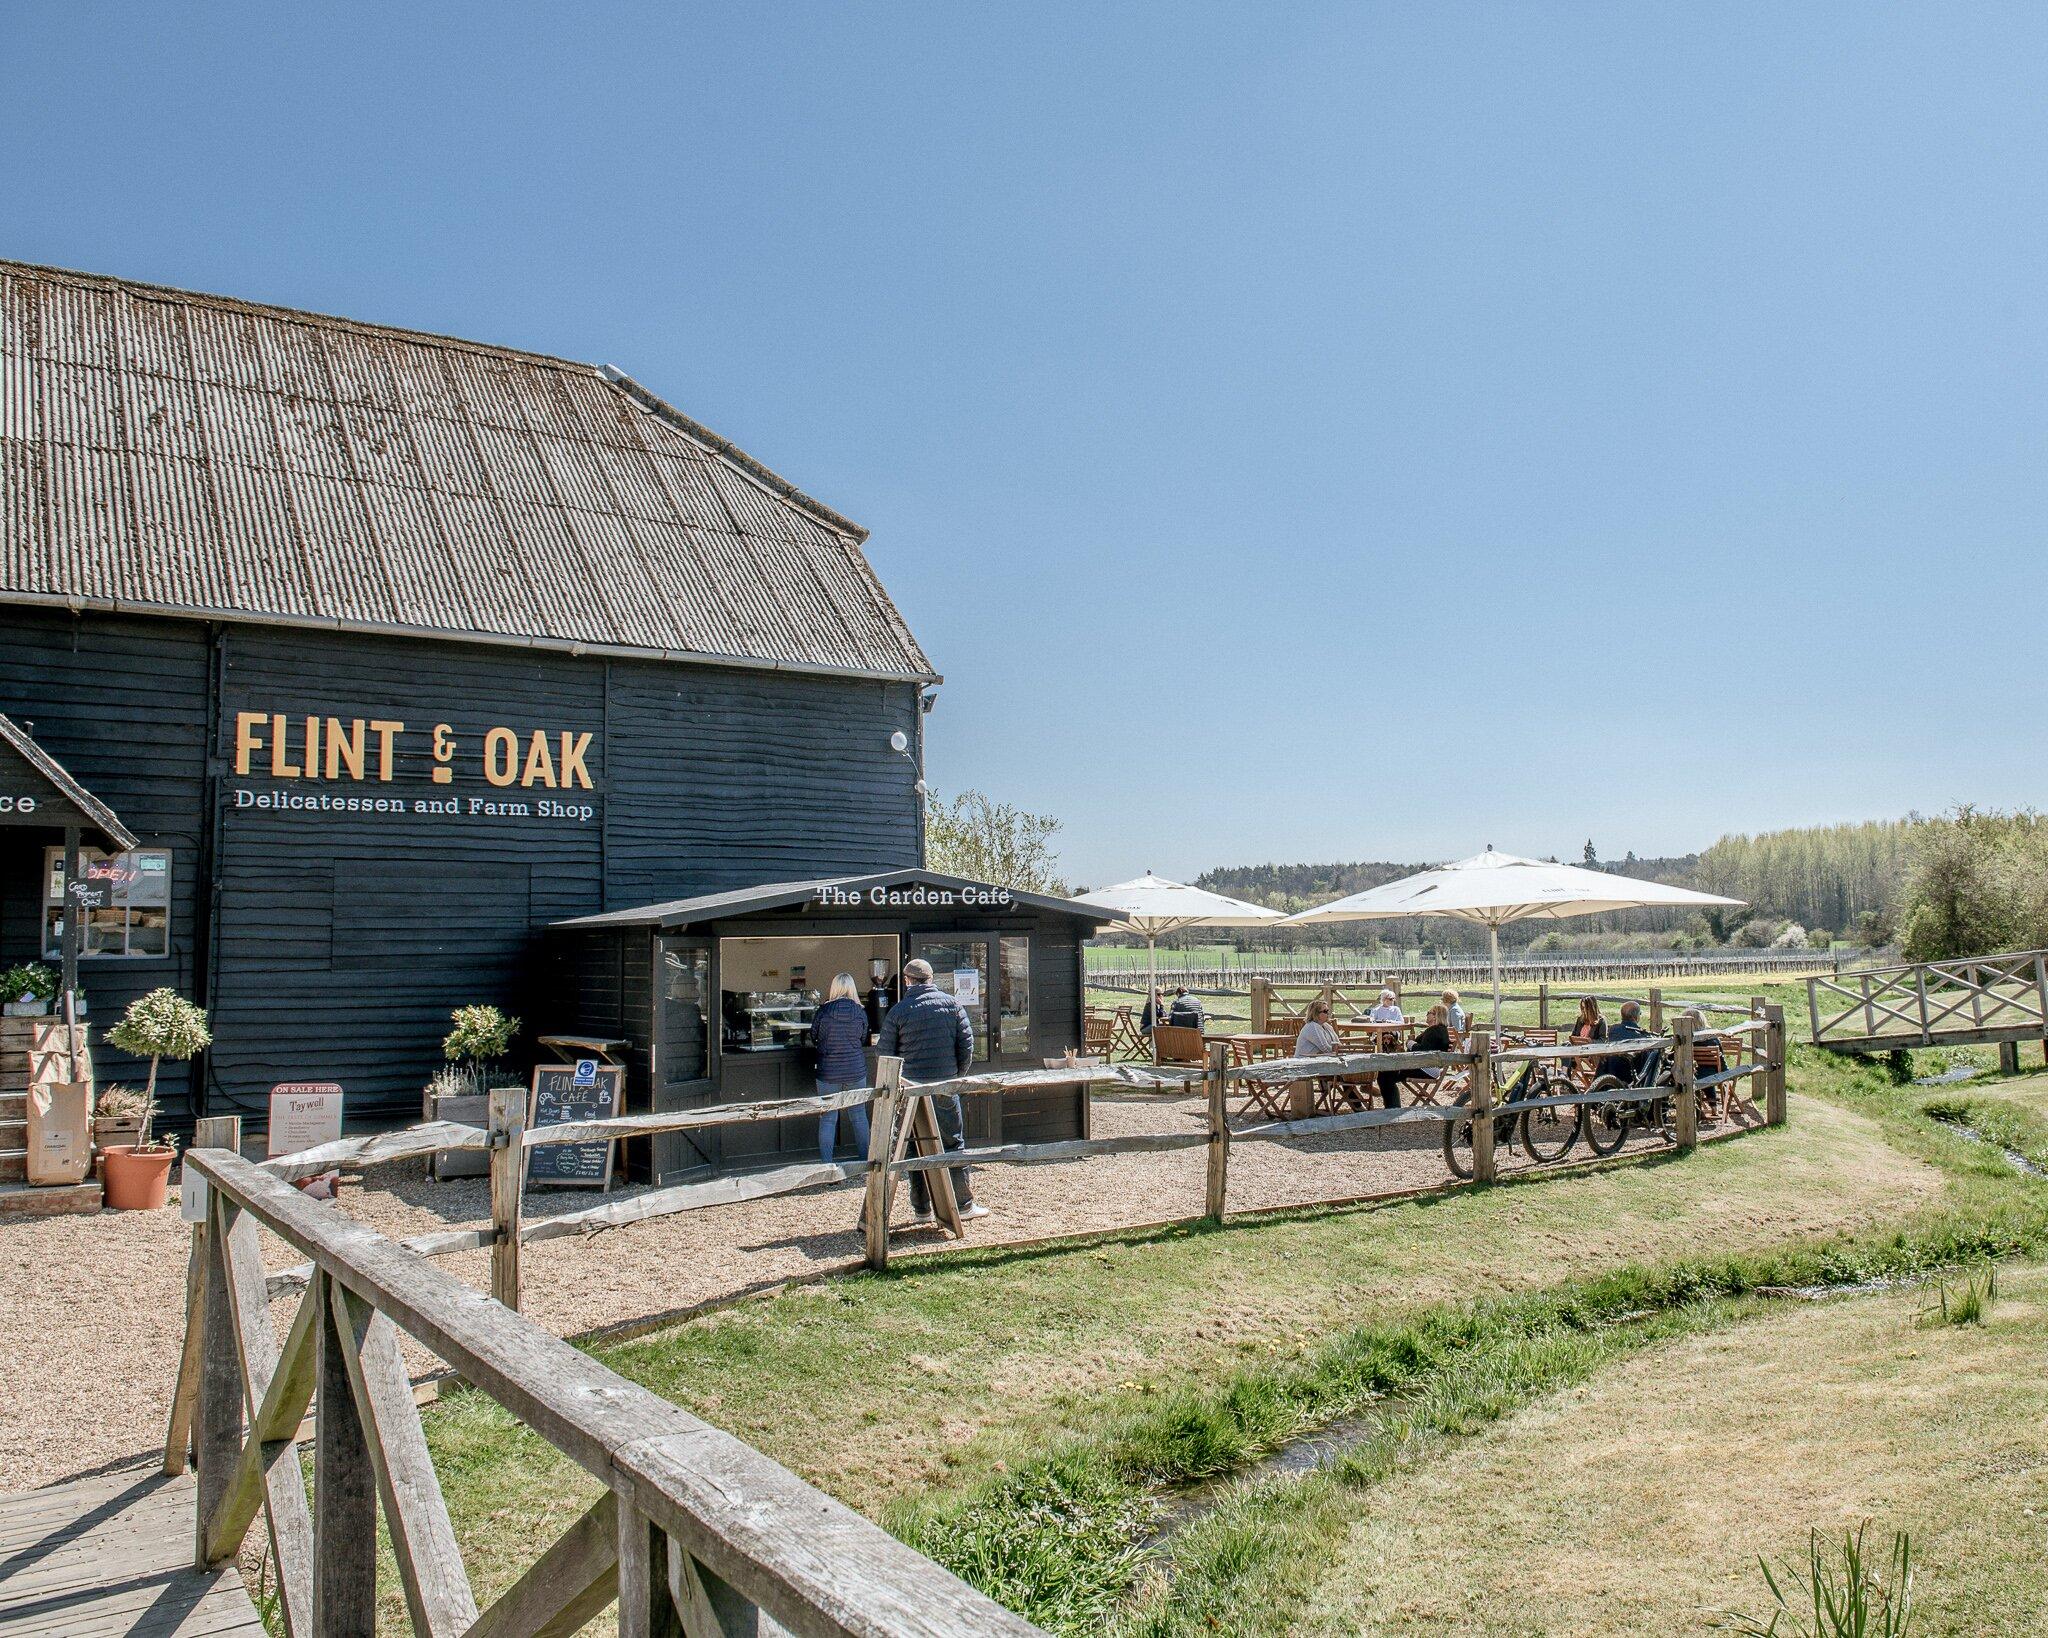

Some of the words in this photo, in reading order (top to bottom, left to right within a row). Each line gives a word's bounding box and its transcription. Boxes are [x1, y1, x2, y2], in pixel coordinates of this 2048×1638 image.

[236, 711, 405, 782] FLINT
[432, 723, 457, 772] &
[483, 726, 594, 789] OAK
[234, 789, 406, 814] Delicatessen
[414, 797, 460, 815] and
[468, 798, 530, 816] Farm
[537, 799, 594, 822] Shop
[816, 886, 862, 905] The
[870, 886, 954, 905] Garden
[961, 886, 1011, 905] Café
[276, 1086, 289, 1094] ON
[588, 1076, 609, 1090] AK
[289, 1097, 325, 1113] Taywell
